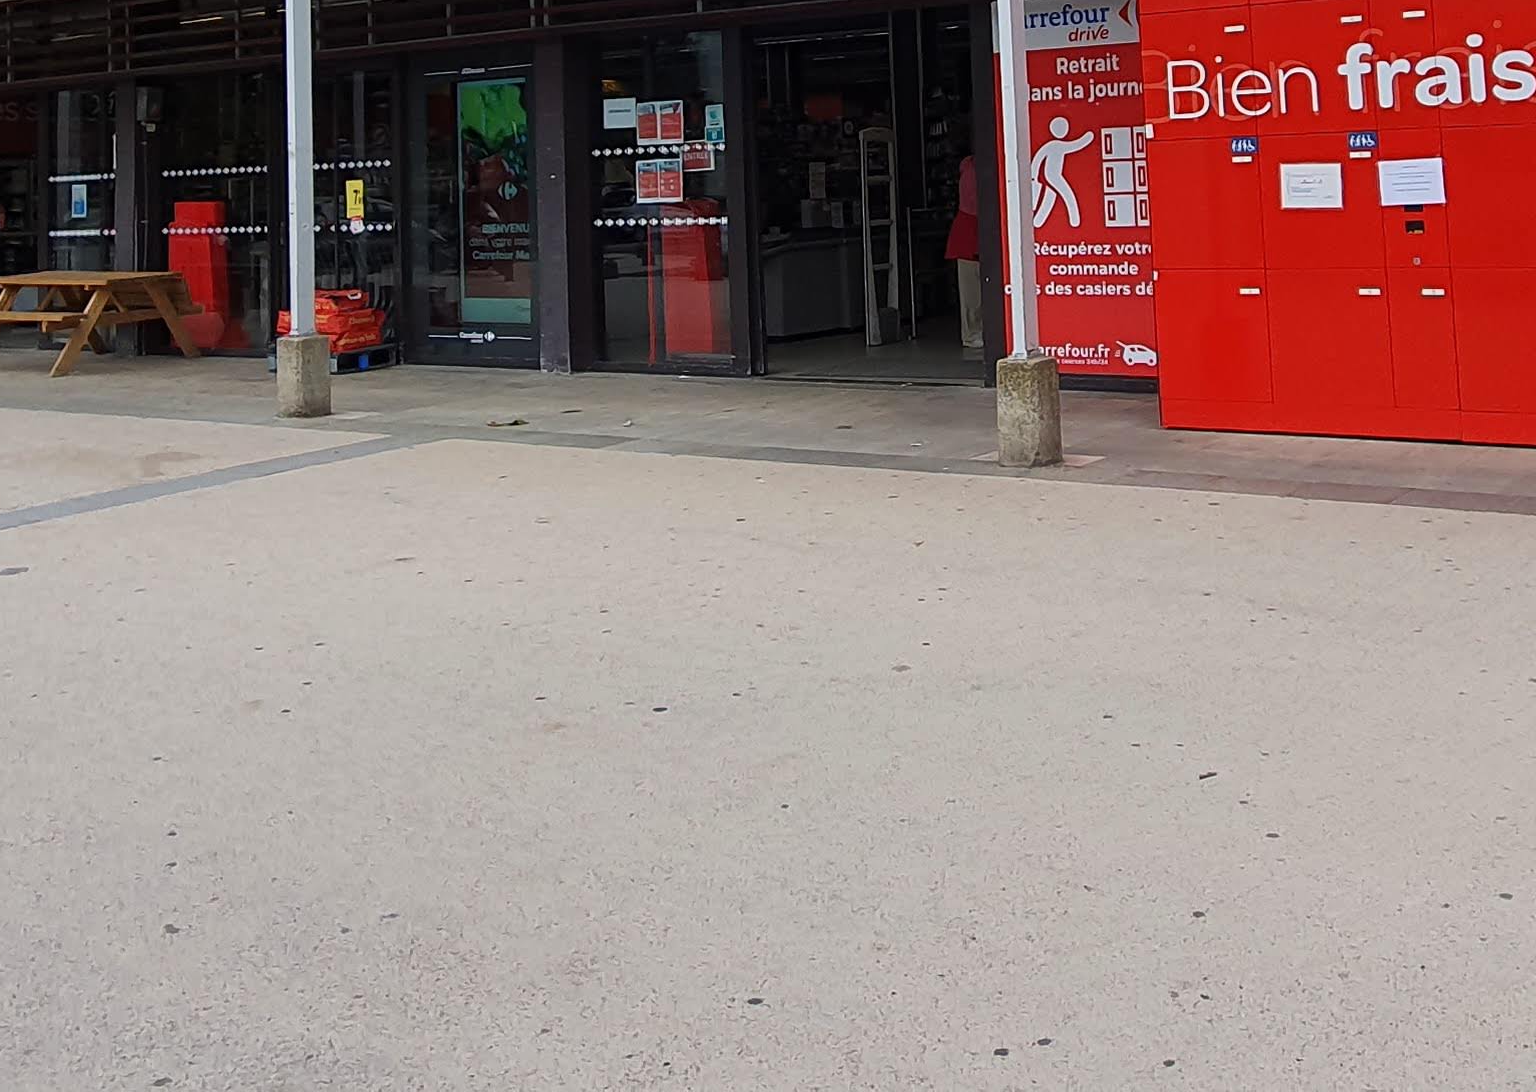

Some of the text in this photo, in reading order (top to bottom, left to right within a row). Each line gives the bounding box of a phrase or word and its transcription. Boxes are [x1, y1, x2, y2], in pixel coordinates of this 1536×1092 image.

[1068, 24, 1110, 42] drive
[1056, 52, 1121, 75] Retrait
[1067, 81, 1085, 99] la
[1166, 55, 1320, 120] Bien
[1049, 261, 1139, 275] commande
[1045, 281, 1072, 295] des
[1076, 281, 1131, 296] casiers
